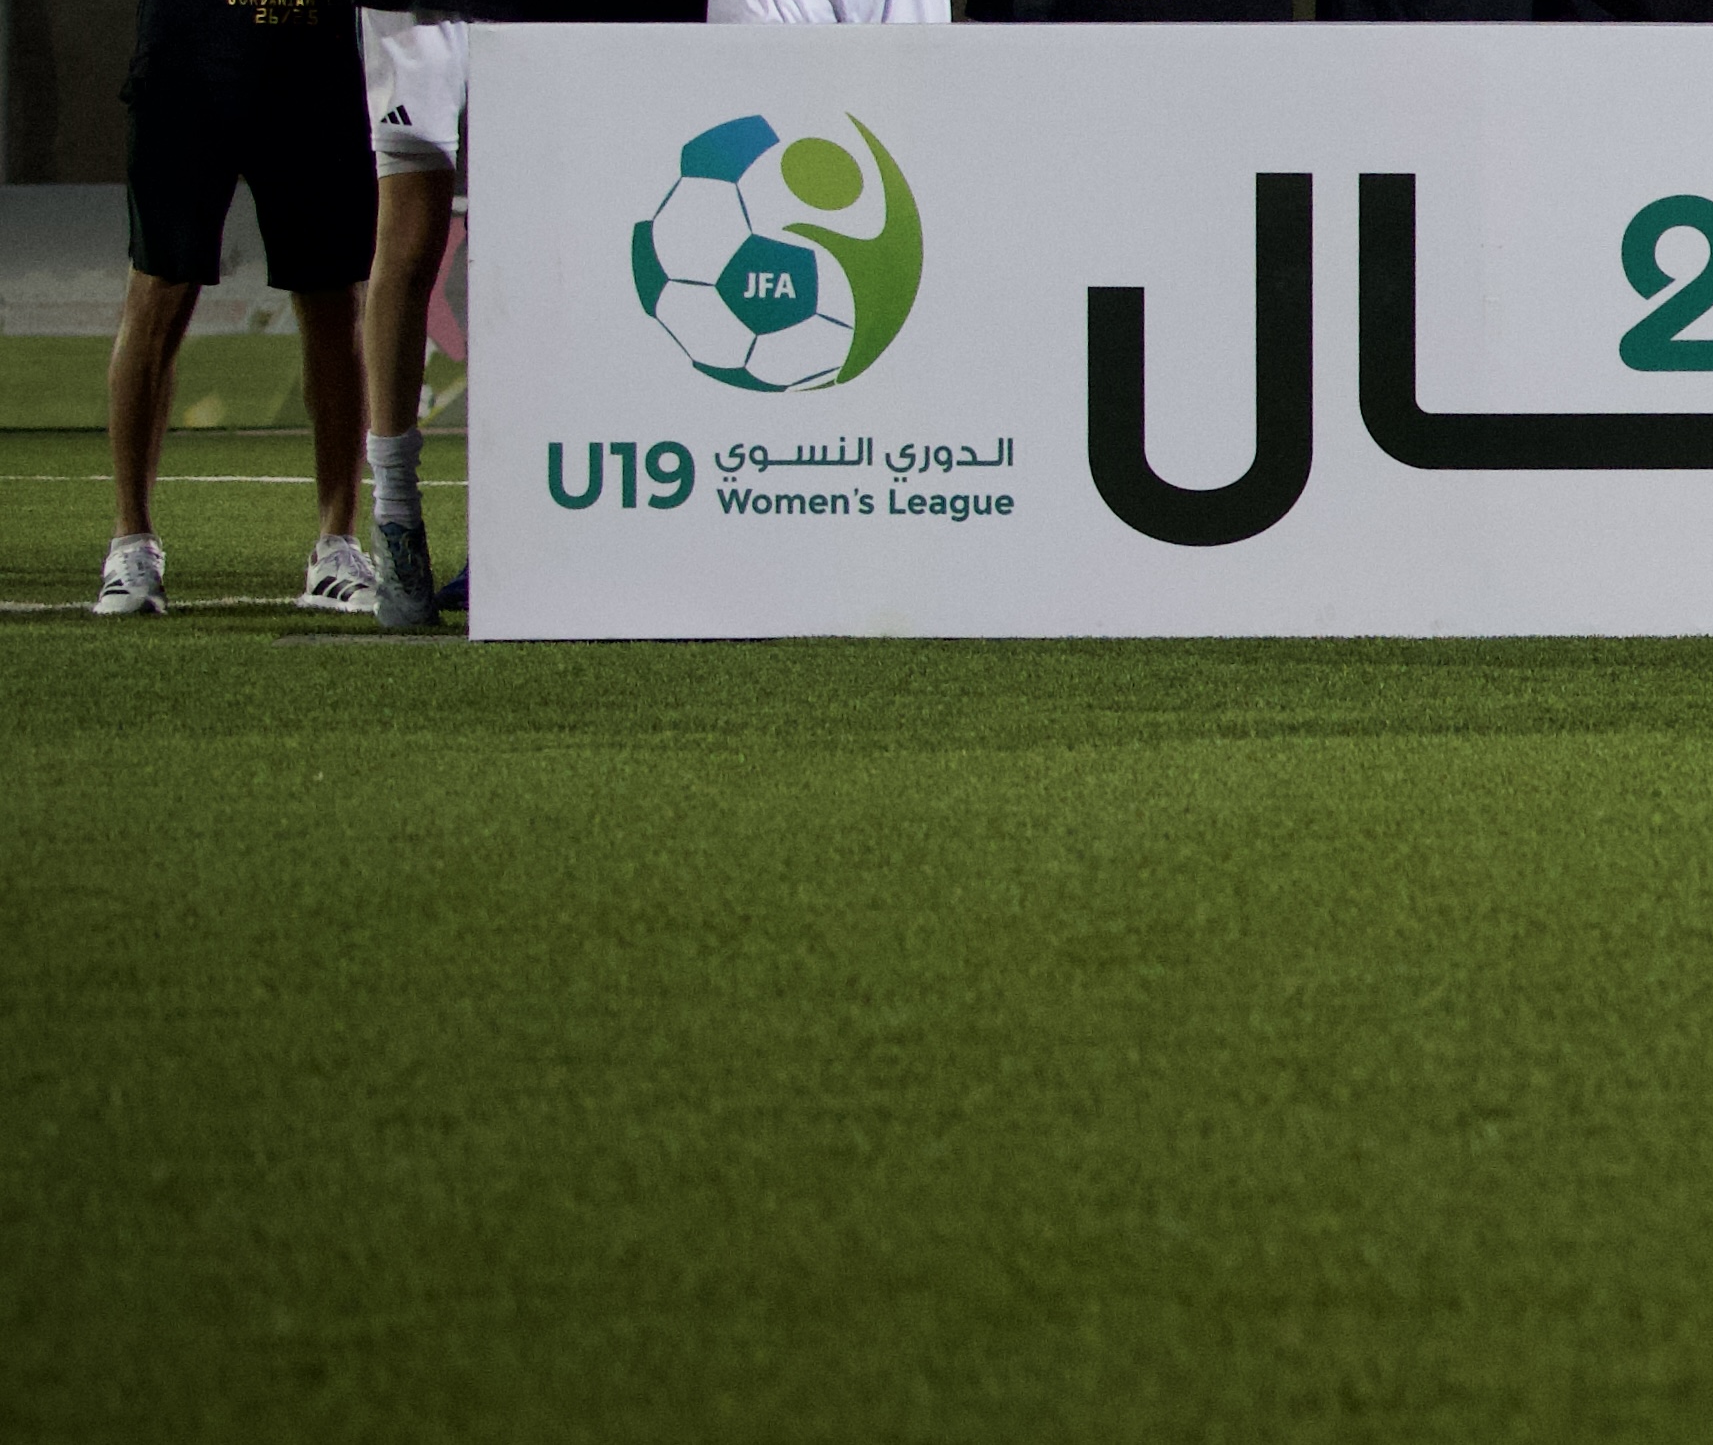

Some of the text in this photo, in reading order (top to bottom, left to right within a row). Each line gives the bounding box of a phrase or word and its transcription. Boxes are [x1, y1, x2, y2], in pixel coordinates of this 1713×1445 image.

[743, 272, 796, 299] JFA
[548, 441, 695, 510] U19
[715, 437, 1014, 483] الدوري النسوي
[717, 488, 1014, 522] Women's League
